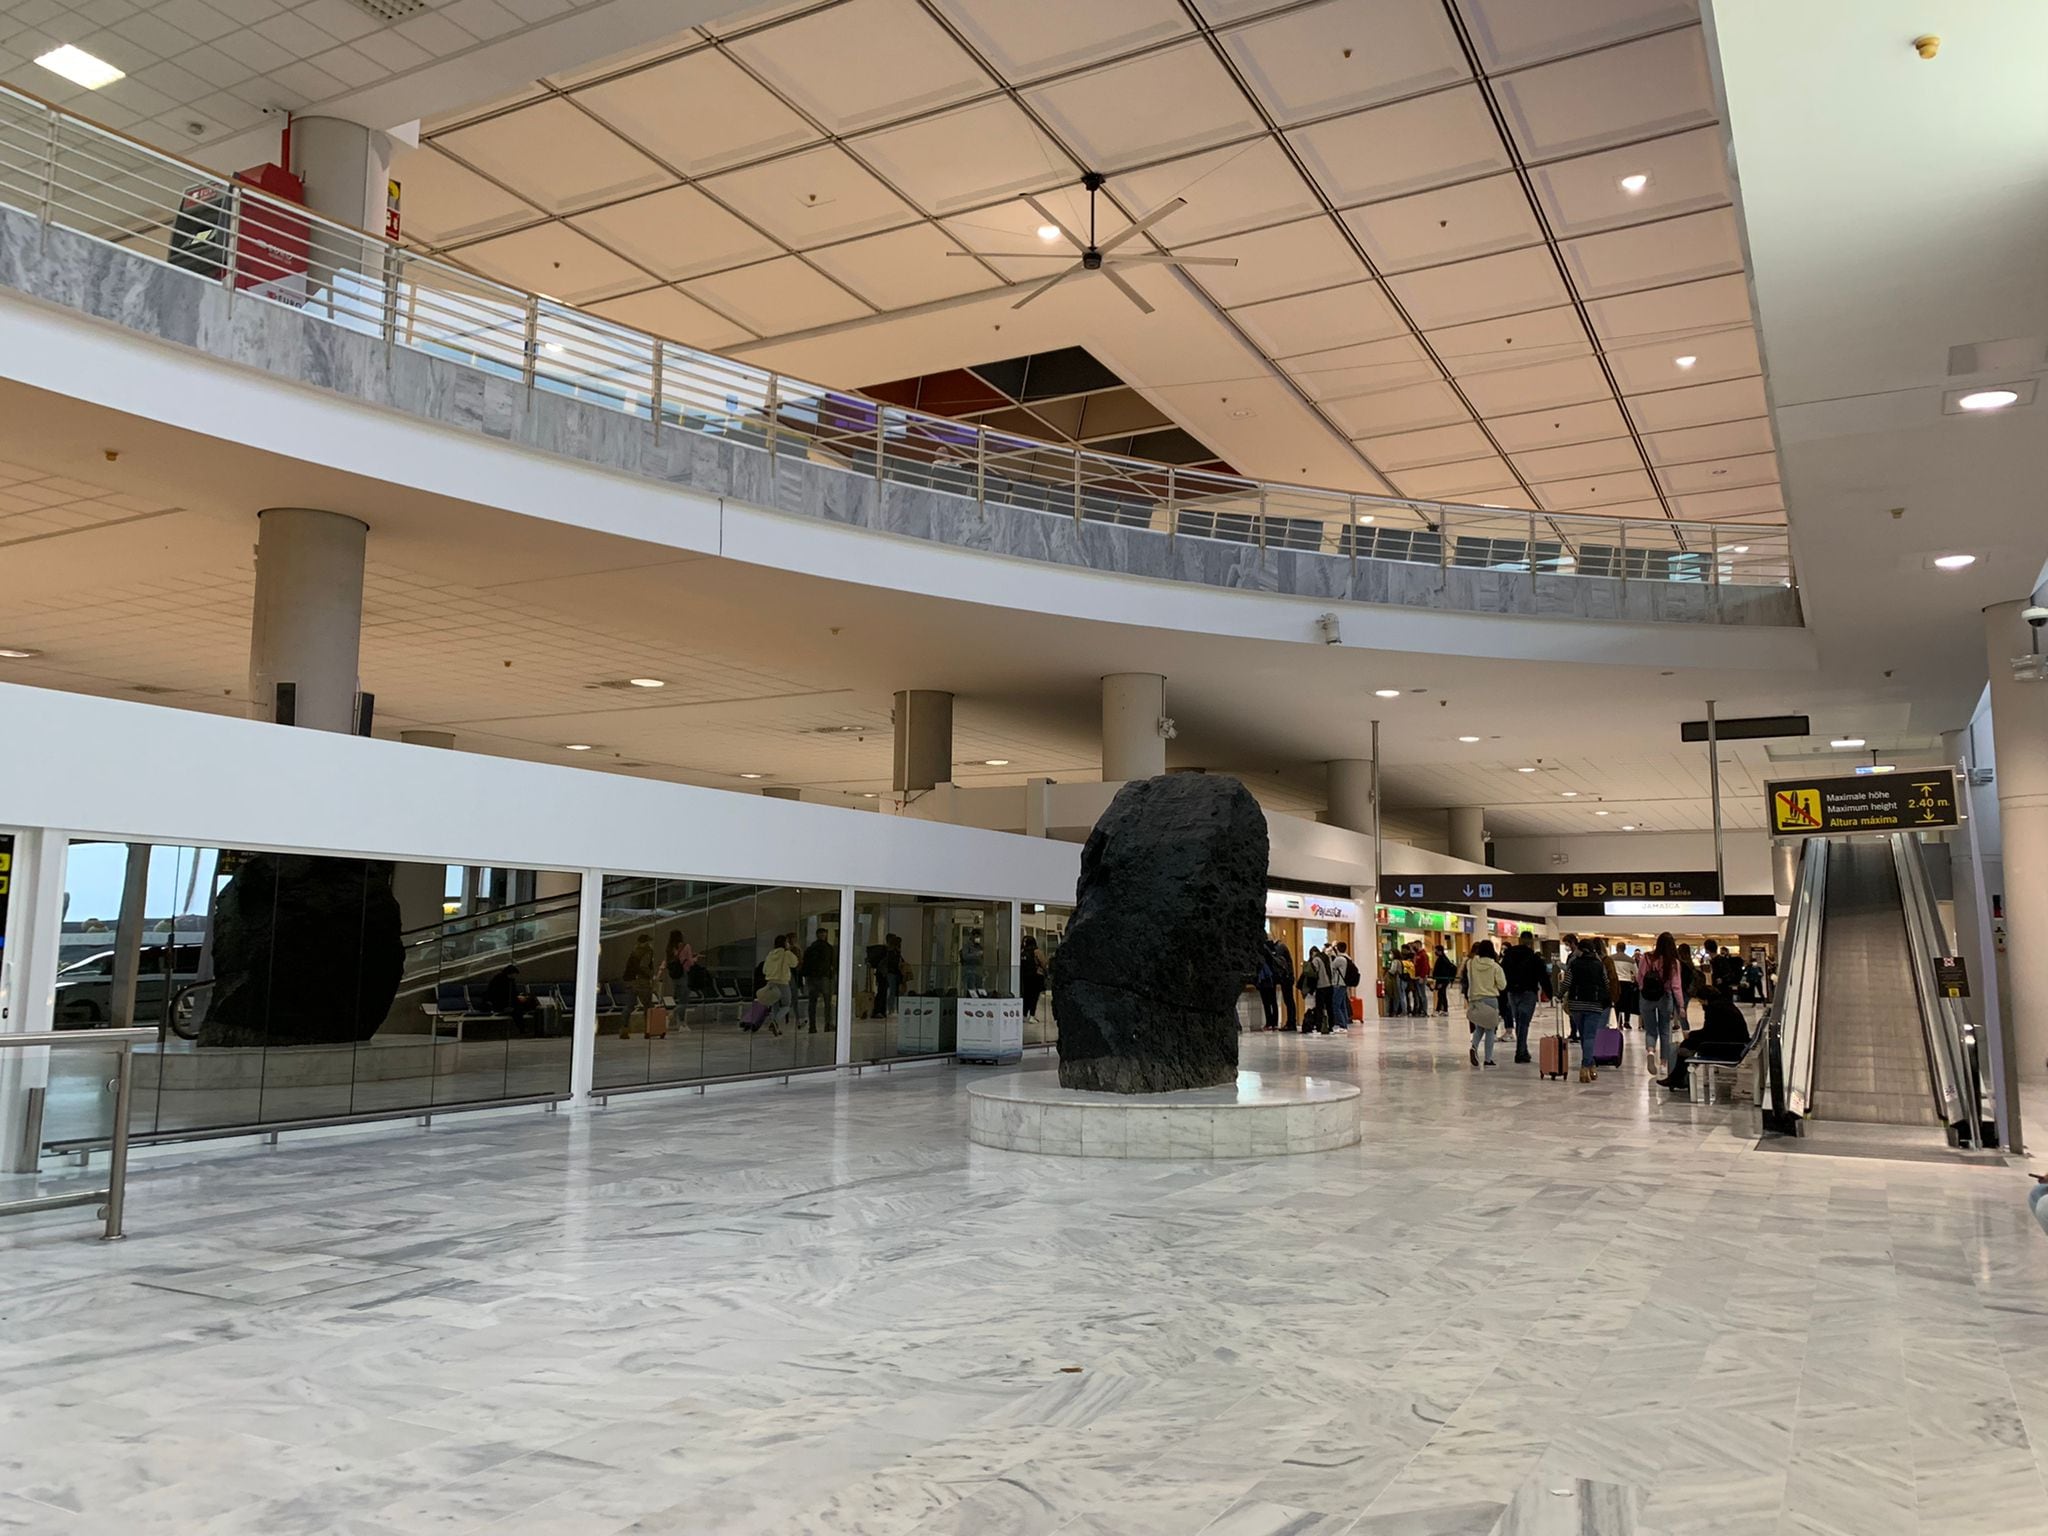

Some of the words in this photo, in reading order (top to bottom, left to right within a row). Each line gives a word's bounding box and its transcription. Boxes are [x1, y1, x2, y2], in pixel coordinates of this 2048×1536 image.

[1826, 793, 1867, 802] Maximale
[1868, 791, 1890, 799] höhe
[1827, 804, 1869, 813] Maximum
[1871, 802, 1898, 811] height
[1908, 798, 1934, 808] 2.40
[1830, 817, 1858, 827] Altura
[1860, 815, 1898, 825] máxima
